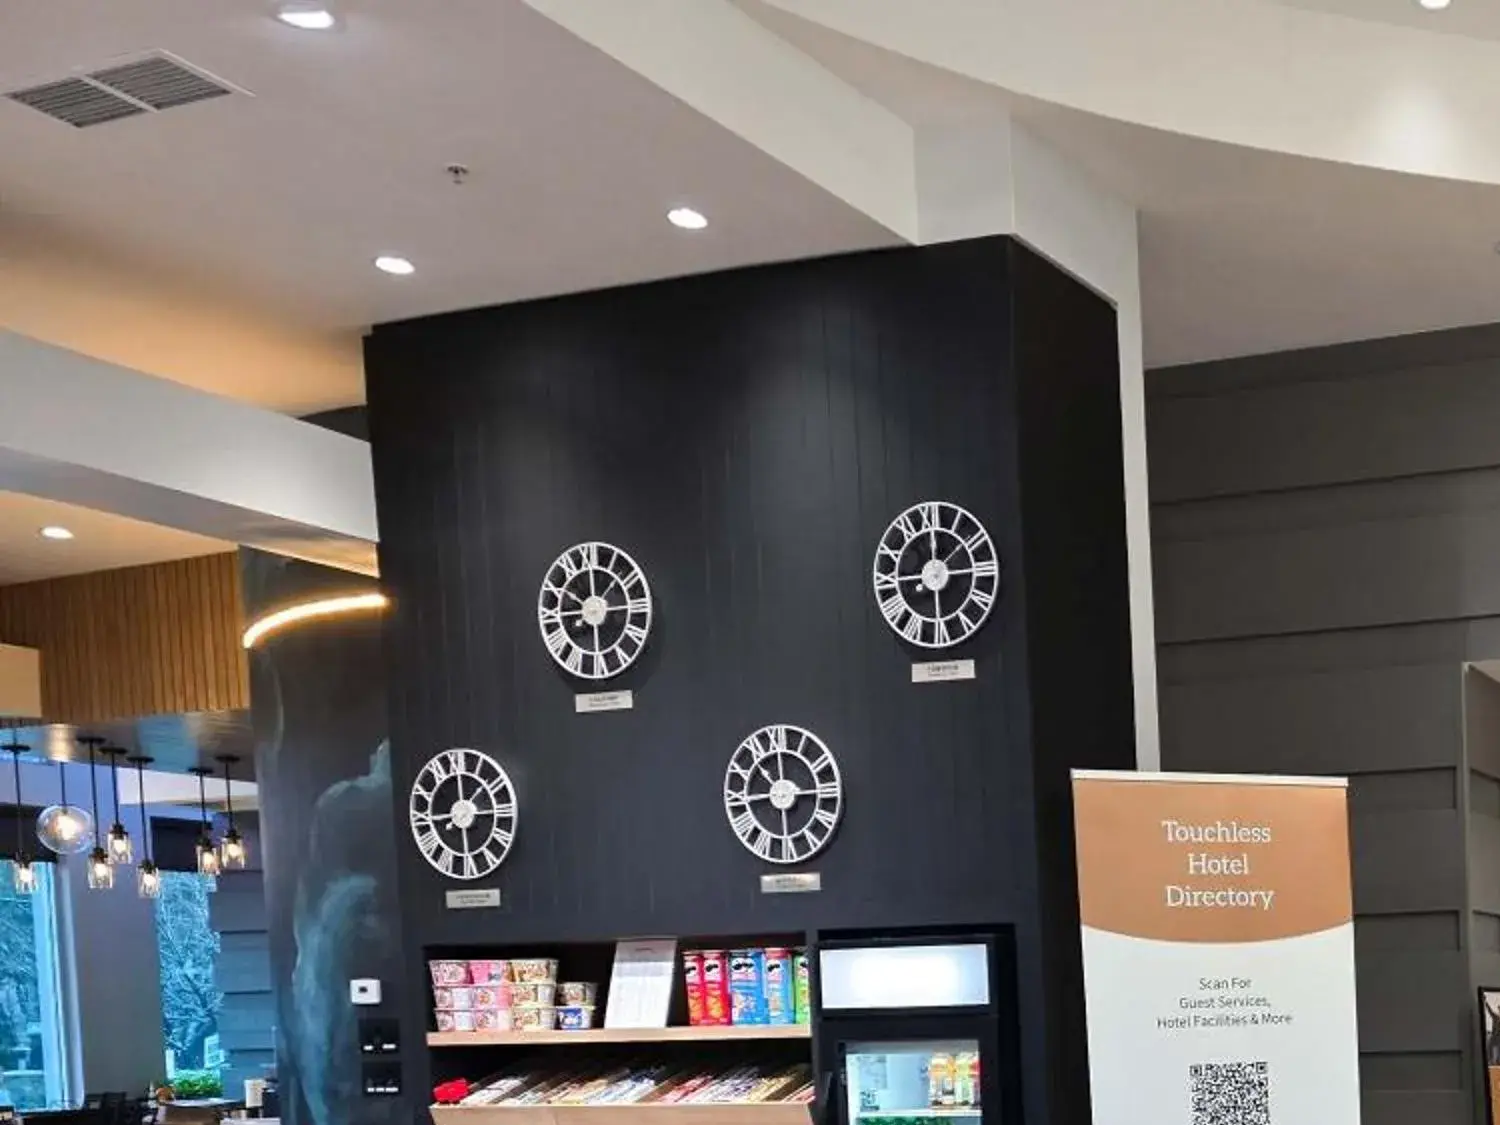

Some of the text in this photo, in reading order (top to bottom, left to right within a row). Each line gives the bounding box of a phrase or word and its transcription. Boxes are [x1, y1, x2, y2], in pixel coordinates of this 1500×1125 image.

[1161, 821, 1271, 844] Touchless
[1187, 853, 1250, 875] Hotel
[1166, 885, 1275, 910] Directory
[1199, 977, 1252, 990] Scan For
[1179, 995, 1271, 1009] Guest Services,
[1157, 1012, 1293, 1028] Hotel Facilities & More
